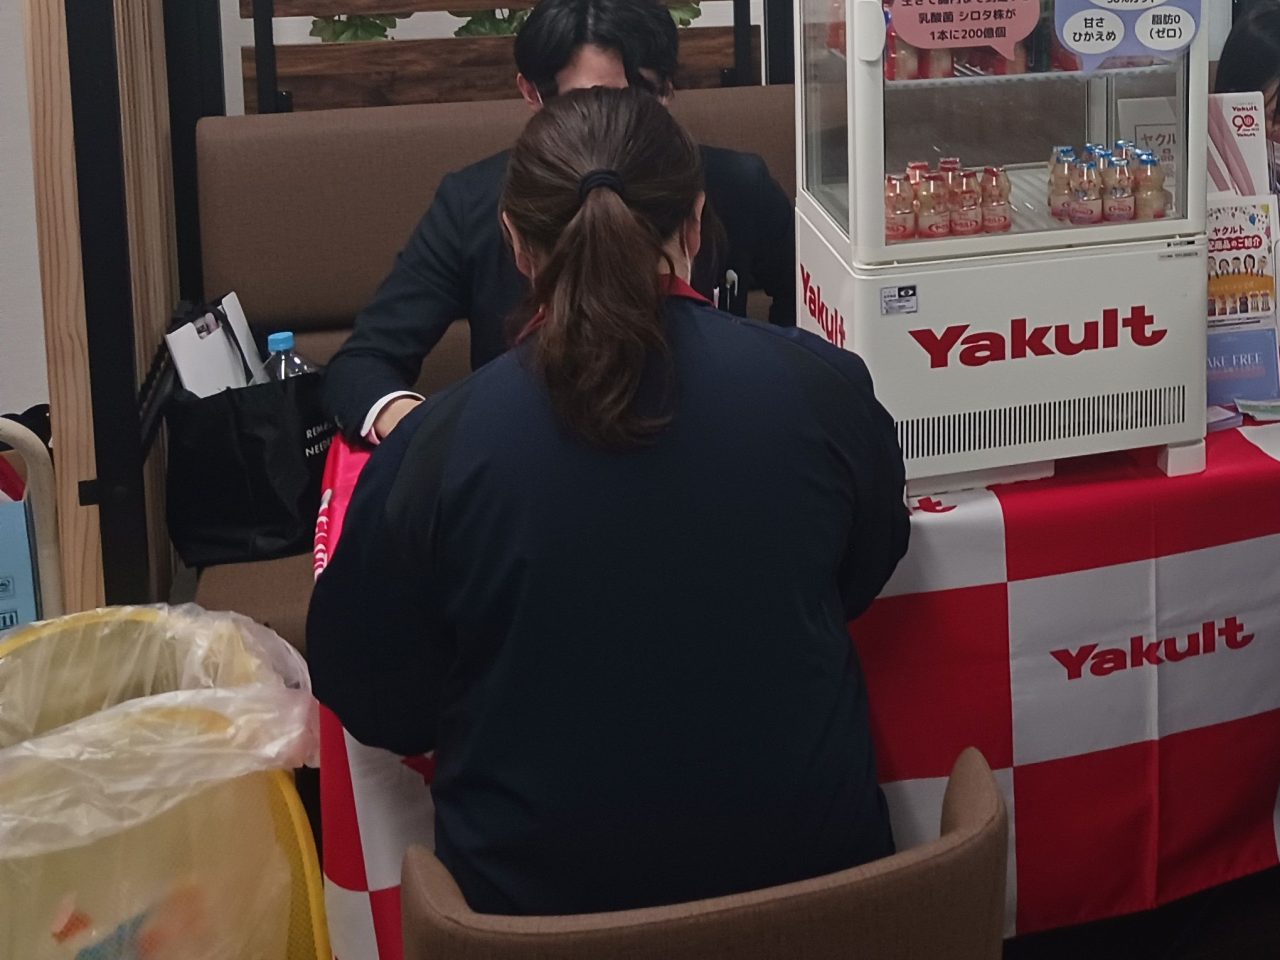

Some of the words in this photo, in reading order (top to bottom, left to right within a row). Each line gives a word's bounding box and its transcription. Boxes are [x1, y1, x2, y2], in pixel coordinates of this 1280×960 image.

[918, 10, 954, 24] 乳酸菌
[958, 8, 1017, 23] シロタ株が
[1083, 16, 1105, 29] 甘さ
[929, 26, 1007, 41] 1本に200億個
[1072, 30, 1117, 43] ひかえめ
[1140, 133, 1176, 146] ヤクル
[800, 263, 846, 348] Yakult
[908, 305, 1168, 370] Yakult
[1050, 616, 1256, 681] Yakult
